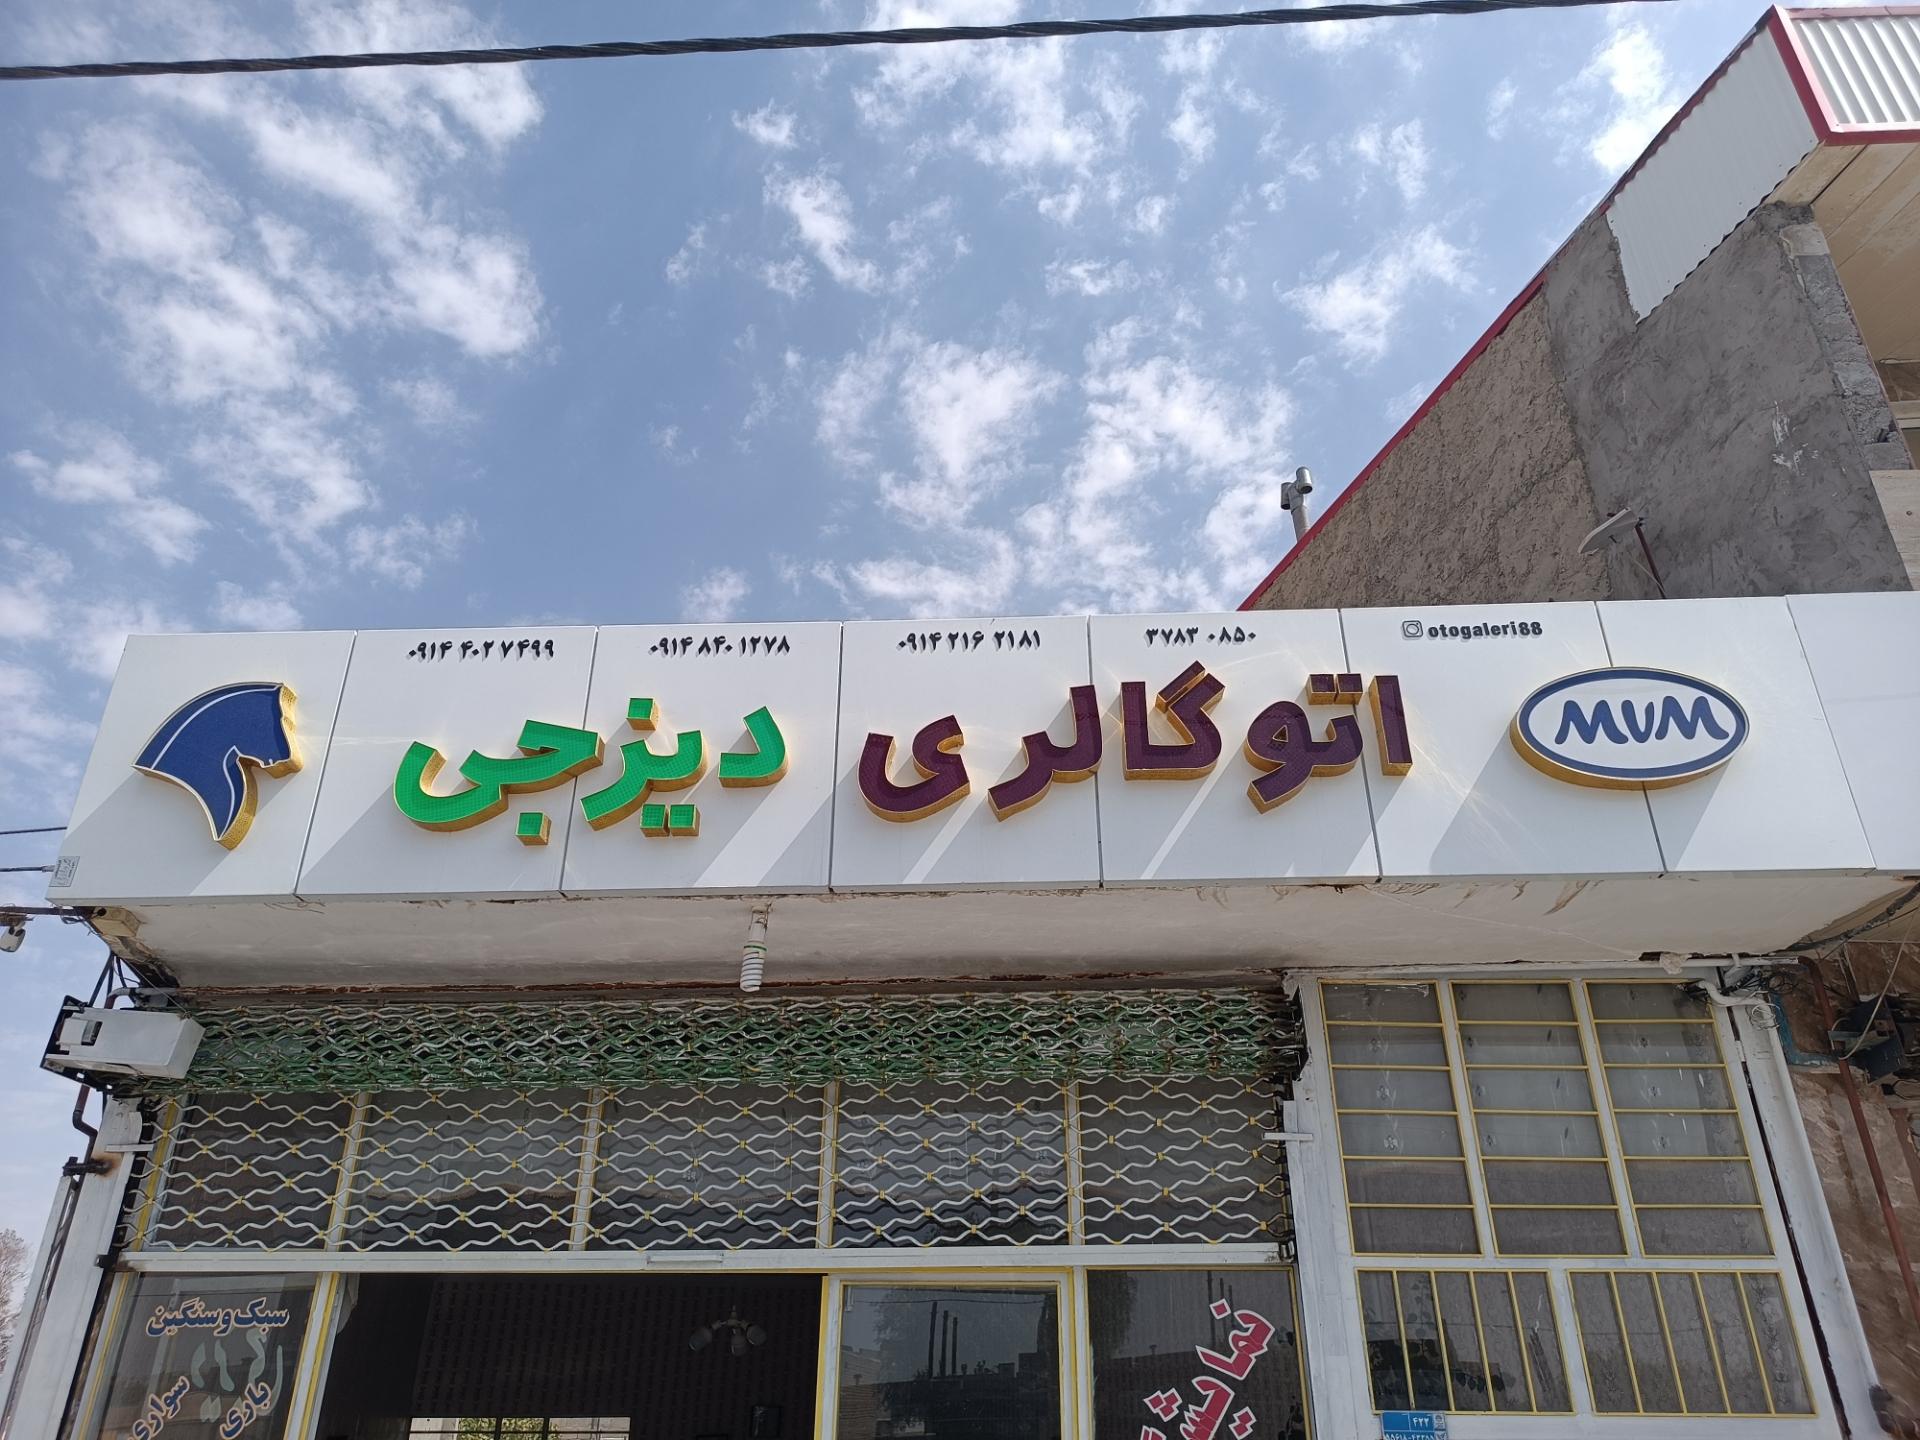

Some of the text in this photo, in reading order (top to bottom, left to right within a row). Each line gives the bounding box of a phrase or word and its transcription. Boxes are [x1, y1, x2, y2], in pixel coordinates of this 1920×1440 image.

[1427, 621, 1543, 640] otogaleri88
[1553, 695, 1730, 745] MVM
[393, 697, 790, 846] دیزجی
[146, 1297, 290, 1336] سبک و سنگین
[219, 1382, 271, 1440] باری
